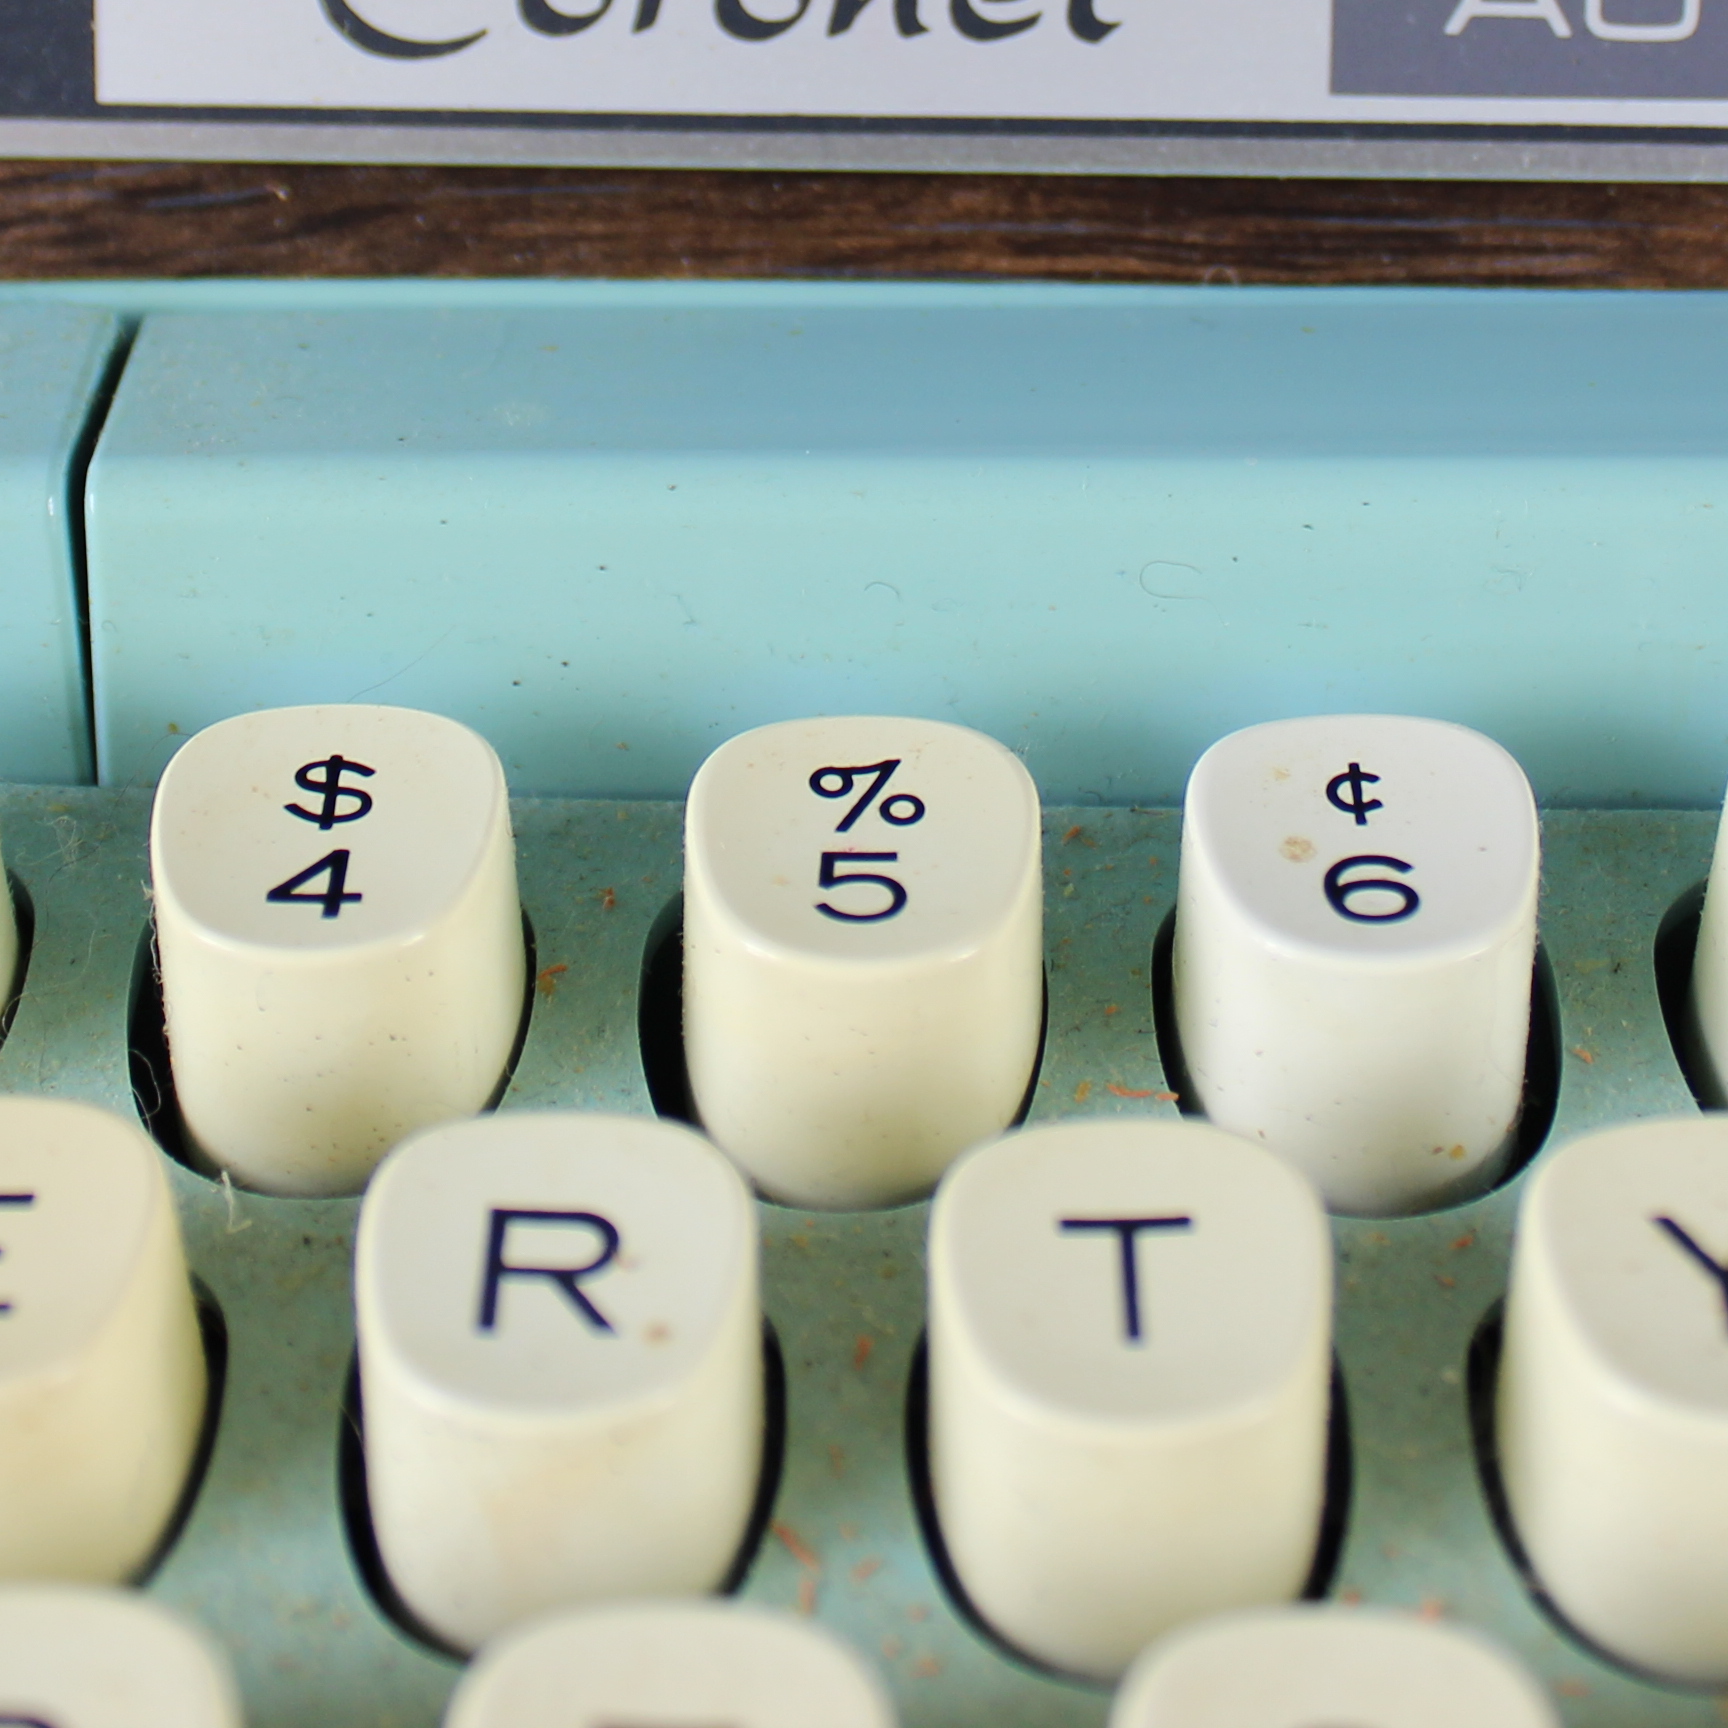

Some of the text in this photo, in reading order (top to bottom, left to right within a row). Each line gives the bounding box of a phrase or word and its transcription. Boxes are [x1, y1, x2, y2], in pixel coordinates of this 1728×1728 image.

[282, 753, 377, 832] $
[807, 757, 927, 834] %
[265, 847, 364, 920] 4
[814, 850, 909, 924] 5
[1322, 853, 1421, 925] 6
[476, 1207, 621, 1333] R
[1057, 1214, 1194, 1343] T
